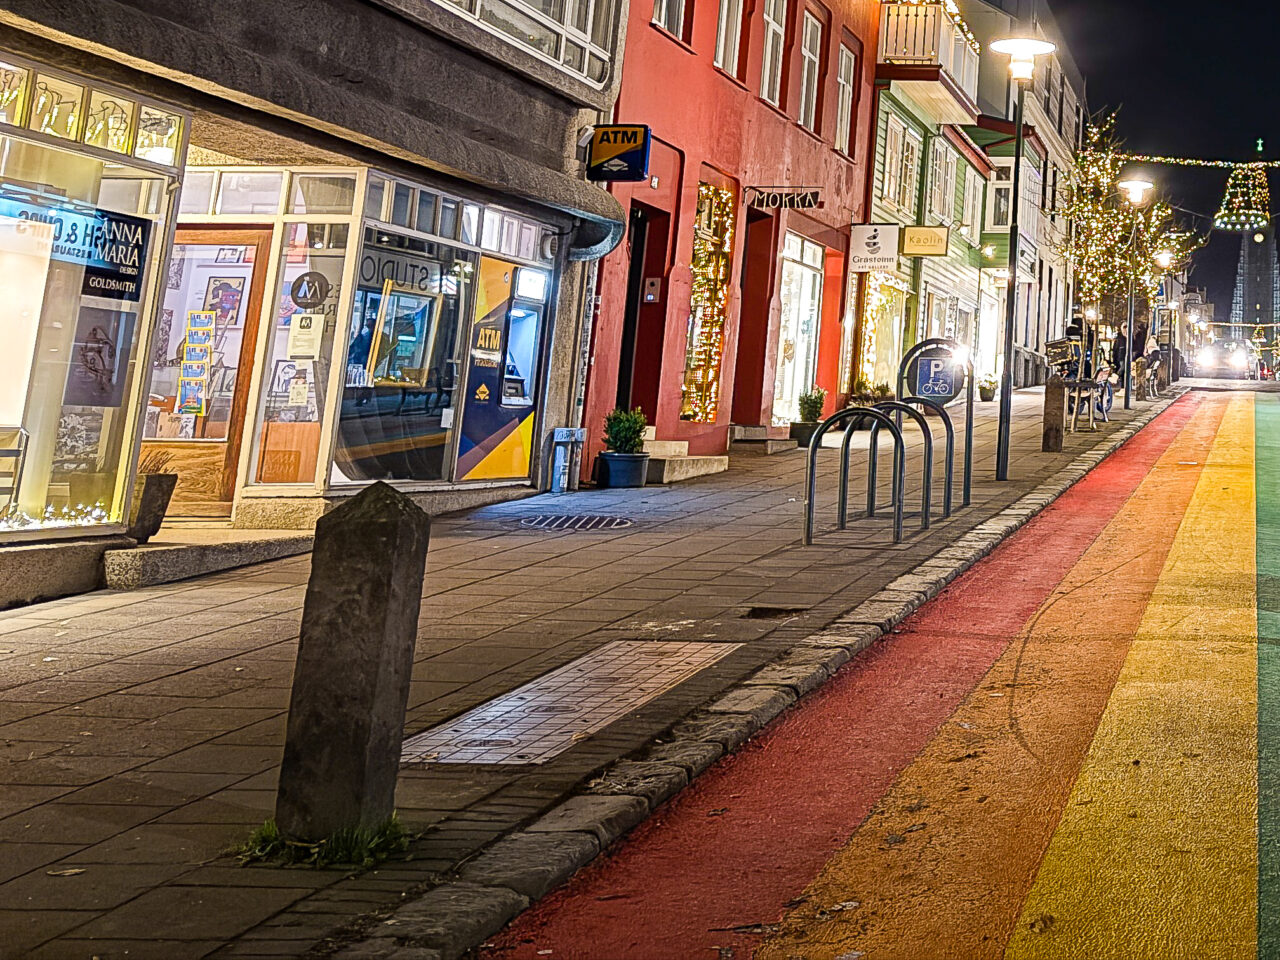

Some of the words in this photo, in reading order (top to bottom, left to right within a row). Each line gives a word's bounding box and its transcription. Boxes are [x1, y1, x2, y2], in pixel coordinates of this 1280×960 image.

[599, 130, 639, 145] ATM
[754, 191, 816, 211] MOKKA
[100, 219, 142, 245] ANNA
[909, 236, 943, 245] Kaolin
[95, 242, 139, 267] MARÍA
[120, 266, 139, 276] DESIGN
[89, 276, 136, 292] GOLDSMITH
[477, 328, 501, 350] ATM
[930, 359, 944, 378] P
